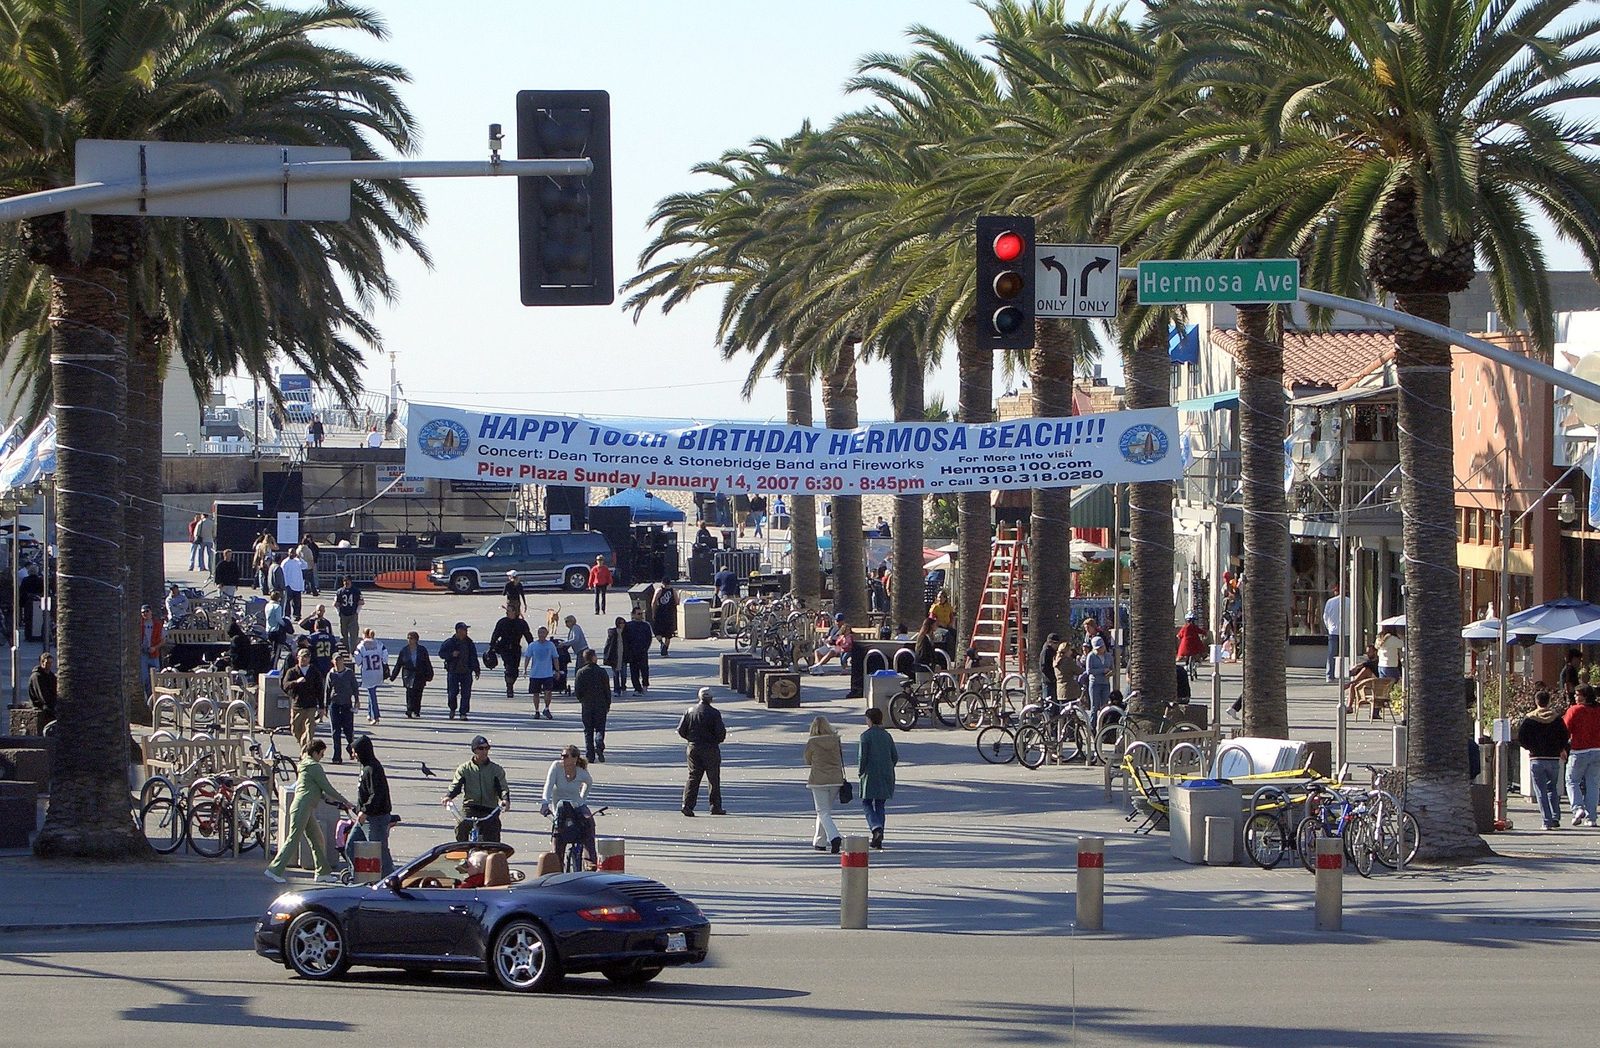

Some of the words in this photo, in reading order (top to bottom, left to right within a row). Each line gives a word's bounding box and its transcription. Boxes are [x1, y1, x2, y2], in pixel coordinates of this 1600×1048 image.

[1144, 272, 1242, 293] Hermosa
[1254, 271, 1293, 292] Ave
[1037, 300, 1067, 312] ONLY
[1079, 300, 1110, 312] ONLY
[478, 415, 578, 444] HAPPY
[589, 427, 668, 448] 100th
[677, 428, 821, 454] BIRTHDAY
[828, 427, 967, 455] HERMOSA
[979, 419, 1106, 449] BEACH!!!
[478, 444, 543, 459] Concert:
[548, 450, 587, 462] Dean
[592, 452, 658, 465] Torrance
[663, 455, 674, 465] &
[679, 456, 771, 471] Stonebridge
[776, 459, 815, 470] Band
[820, 460, 847, 470] and
[853, 459, 924, 470] Fireworks
[1047, 450, 1073, 458] visit
[940, 460, 1092, 475] Hermosa100.com
[477, 462, 513, 477] Pier
[519, 464, 568, 481] Plaza
[574, 467, 641, 488] Sunday
[646, 471, 719, 491] January
[726, 475, 751, 492] 14,
[757, 476, 799, 490] 2007
[805, 476, 843, 490] 6:30
[860, 476, 925, 493] 8:45pm
[949, 478, 973, 487] Call
[979, 470, 1104, 485] 310.318.0280
[341, 593, 354, 607] 34
[315, 641, 331, 657] 23
[364, 654, 381, 671] 12
